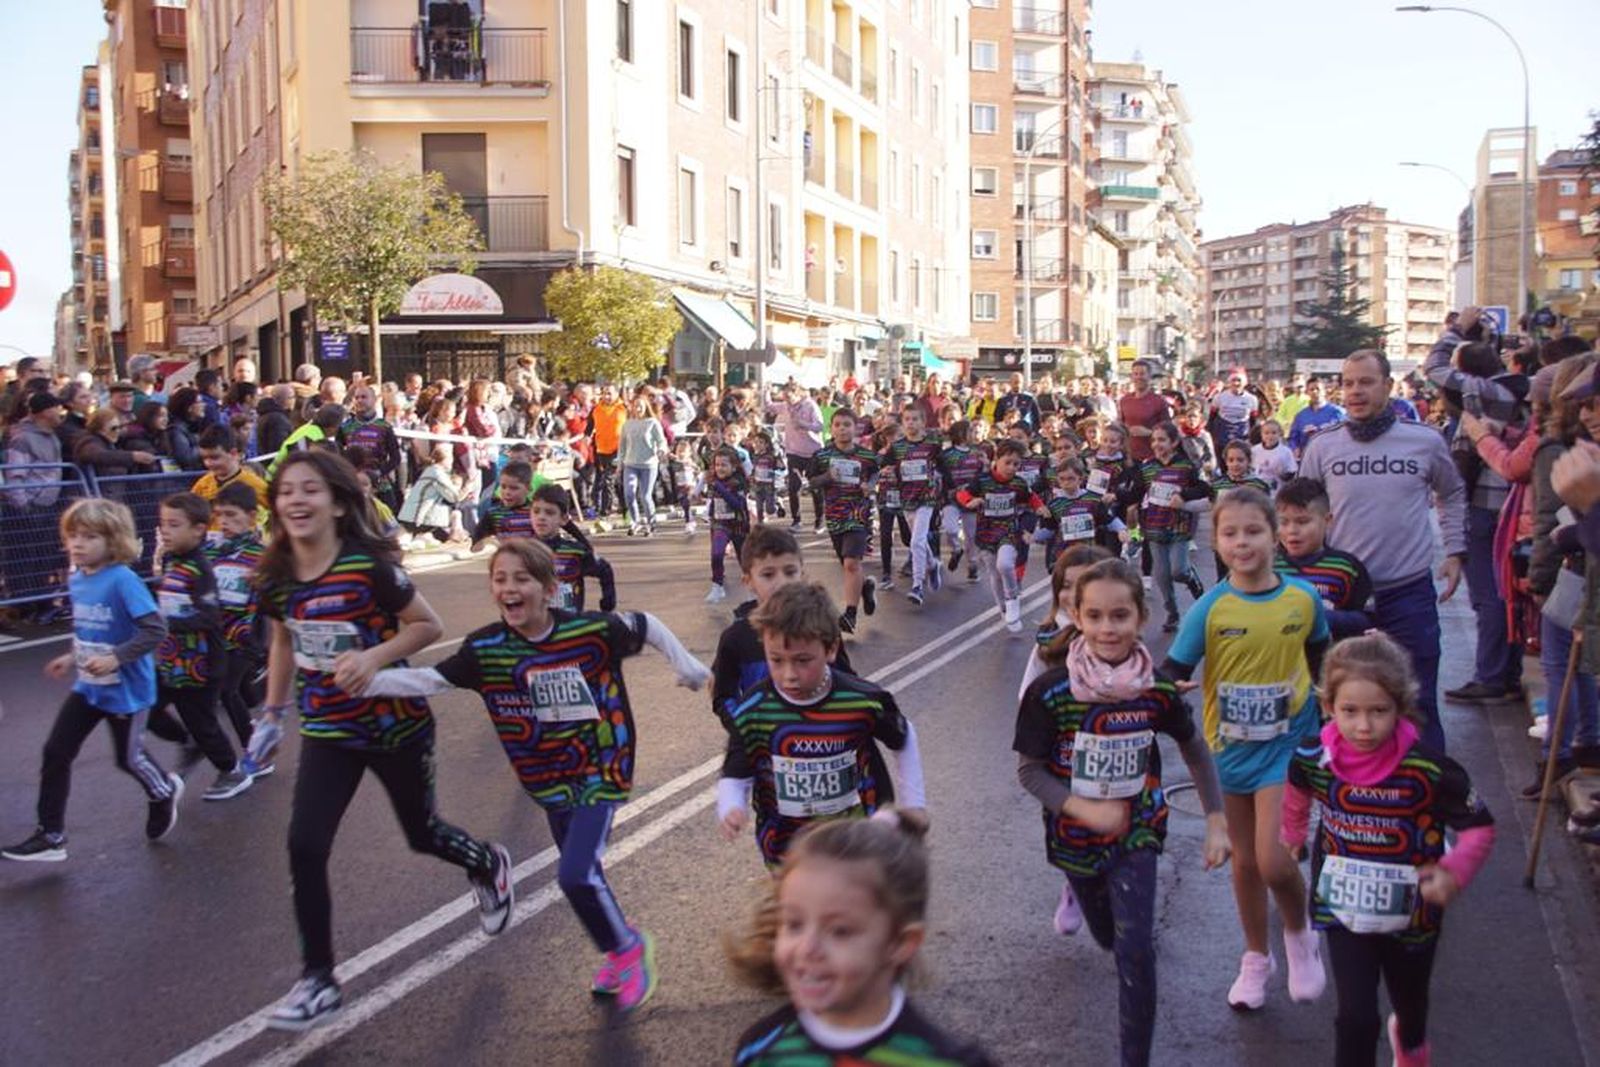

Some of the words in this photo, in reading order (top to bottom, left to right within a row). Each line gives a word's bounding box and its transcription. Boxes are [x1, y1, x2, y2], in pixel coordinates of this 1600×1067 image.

[1331, 455, 1419, 476] adidas
[1226, 697, 1277, 722] 5973
[1084, 750, 1139, 778] 6298
[784, 771, 841, 798] 6348
[1328, 874, 1392, 911] 5969
